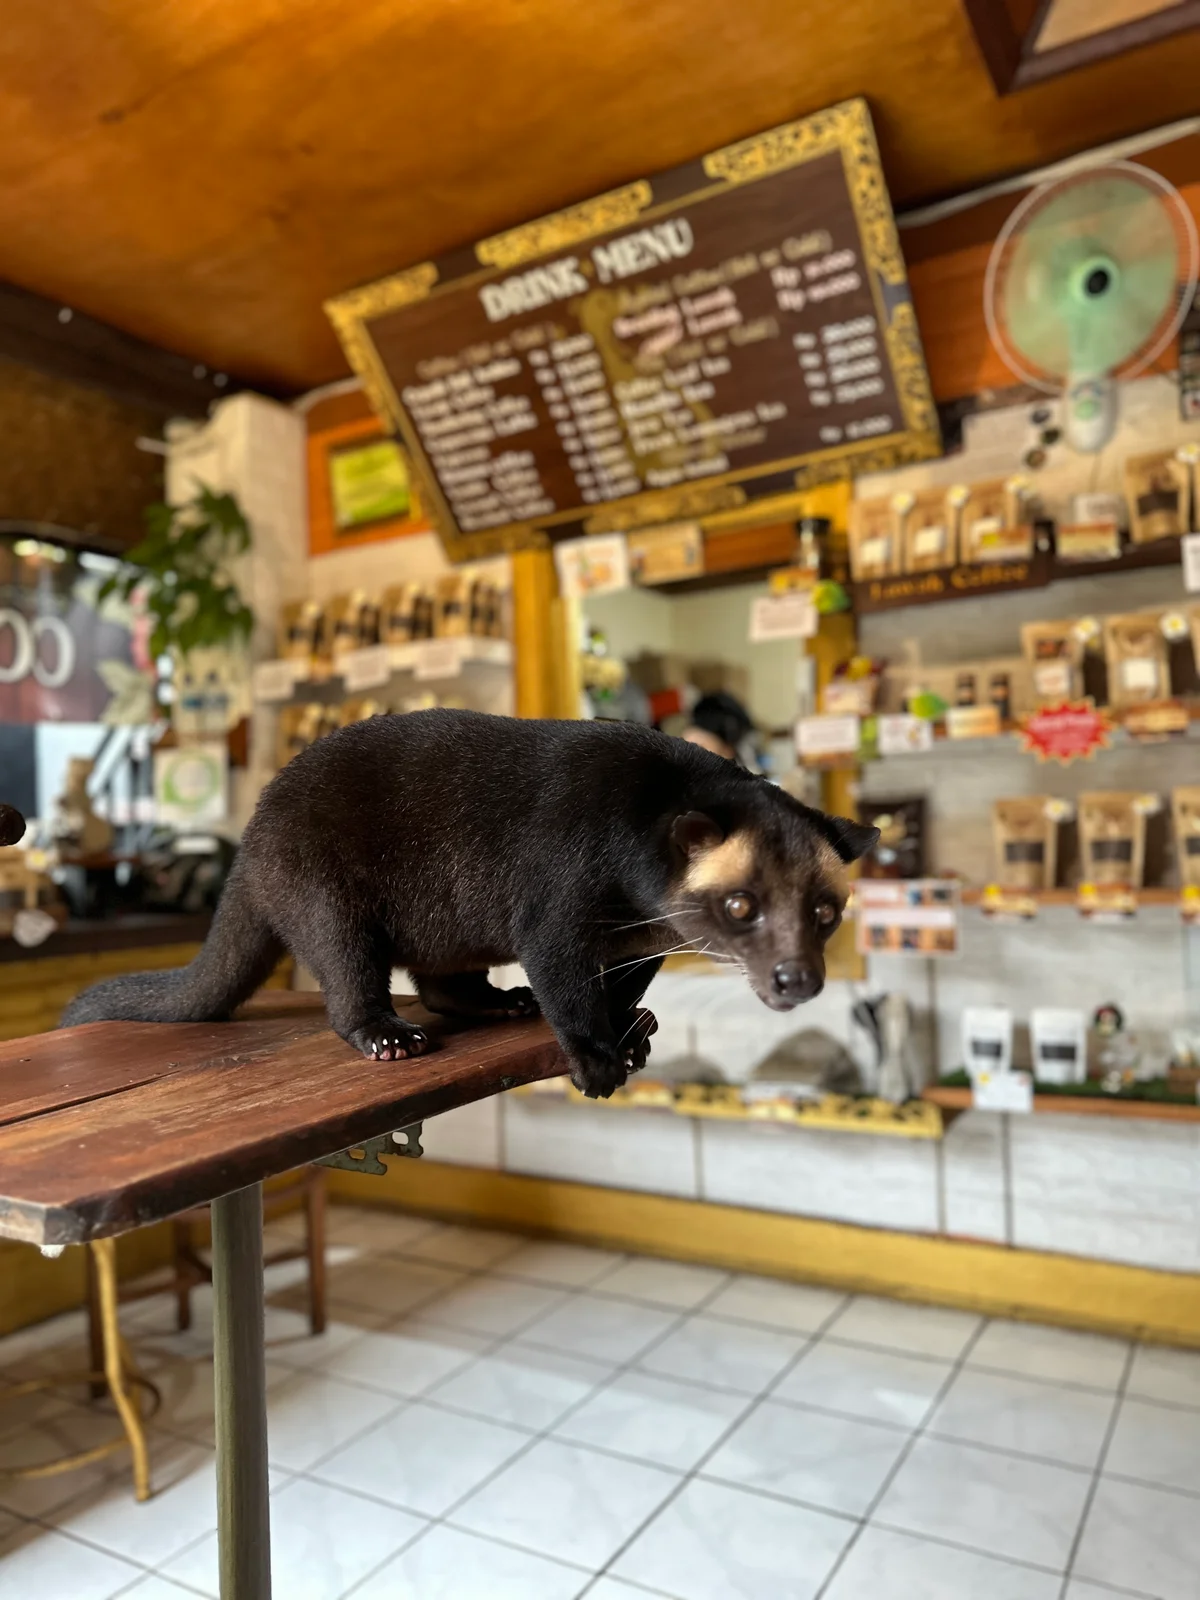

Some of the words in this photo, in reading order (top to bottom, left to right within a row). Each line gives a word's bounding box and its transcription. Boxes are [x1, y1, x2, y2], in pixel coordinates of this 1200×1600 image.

[479, 256, 588, 322] DRINK
[592, 218, 694, 283] MENU
[950, 563, 1028, 589] Coffee
